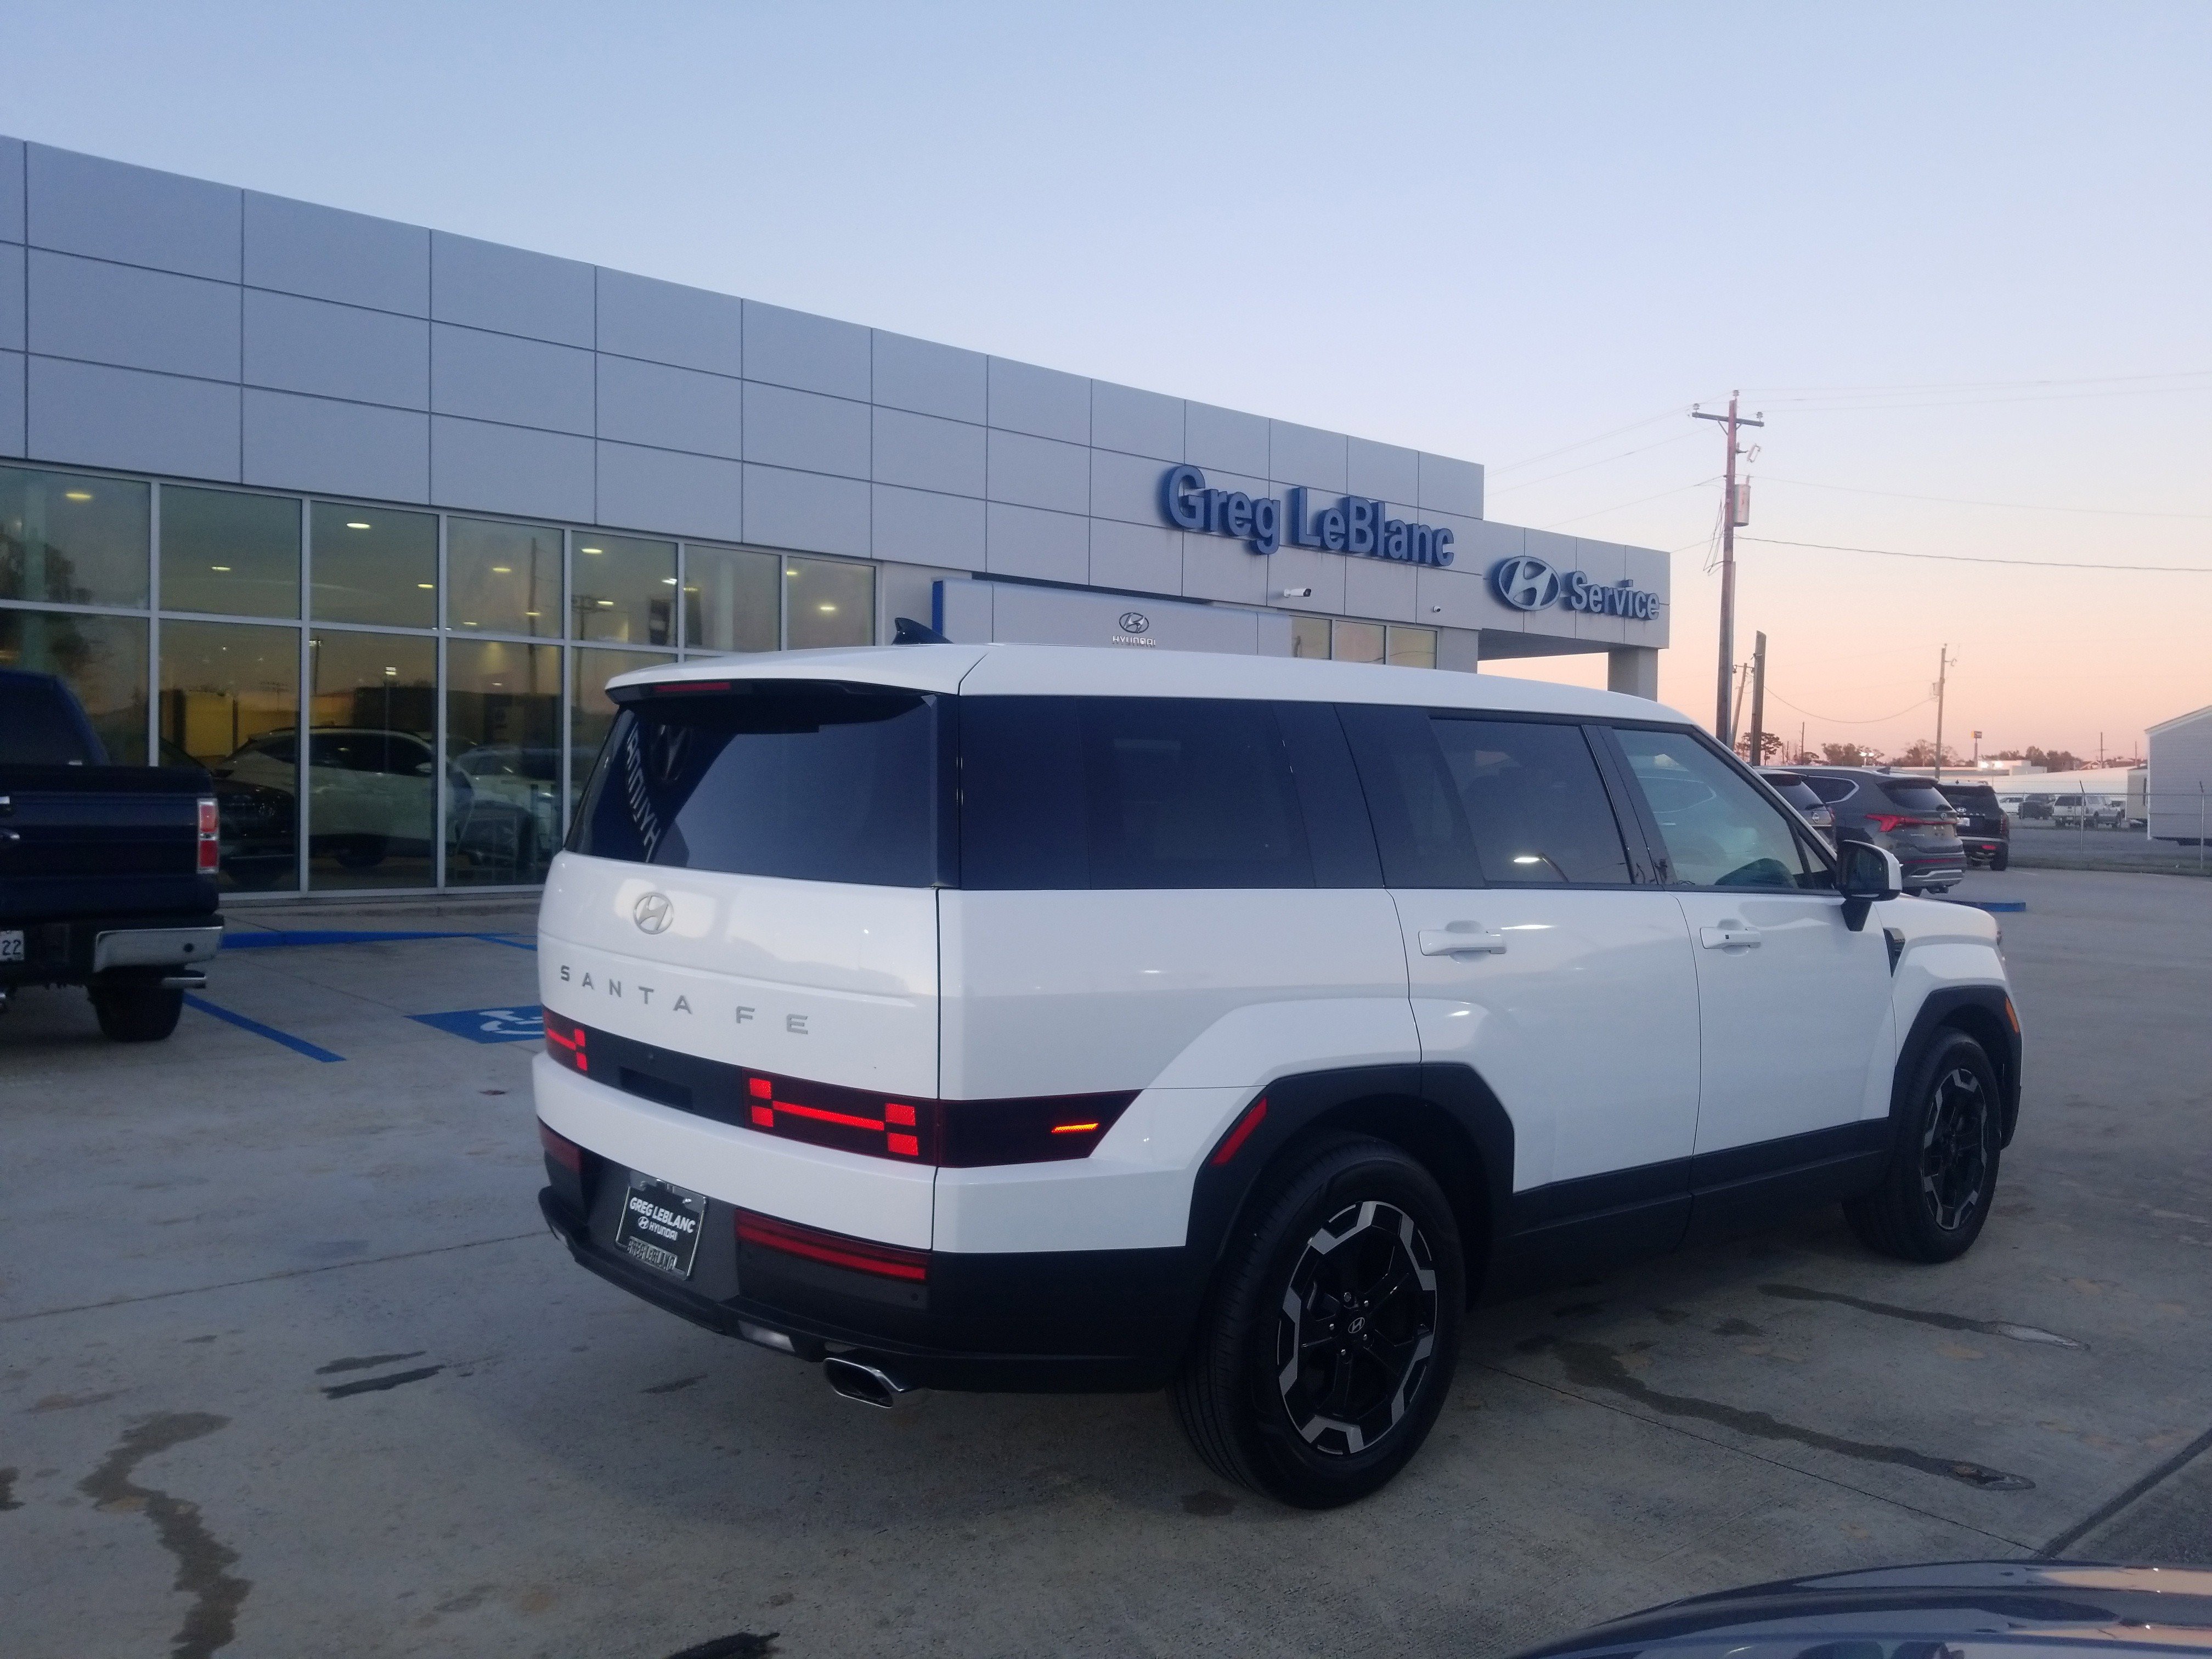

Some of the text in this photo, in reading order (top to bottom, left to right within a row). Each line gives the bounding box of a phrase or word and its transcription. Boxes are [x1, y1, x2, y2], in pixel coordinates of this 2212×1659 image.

[1162, 465, 1455, 567] Greg LeBlanc
[1567, 570, 1660, 620] Service
[1113, 635, 1155, 646] HYUNDAI
[561, 966, 808, 1035] SANTA FE
[630, 1197, 696, 1233] GREG LEBLANC
[649, 1221, 679, 1241] HYUNDAI
